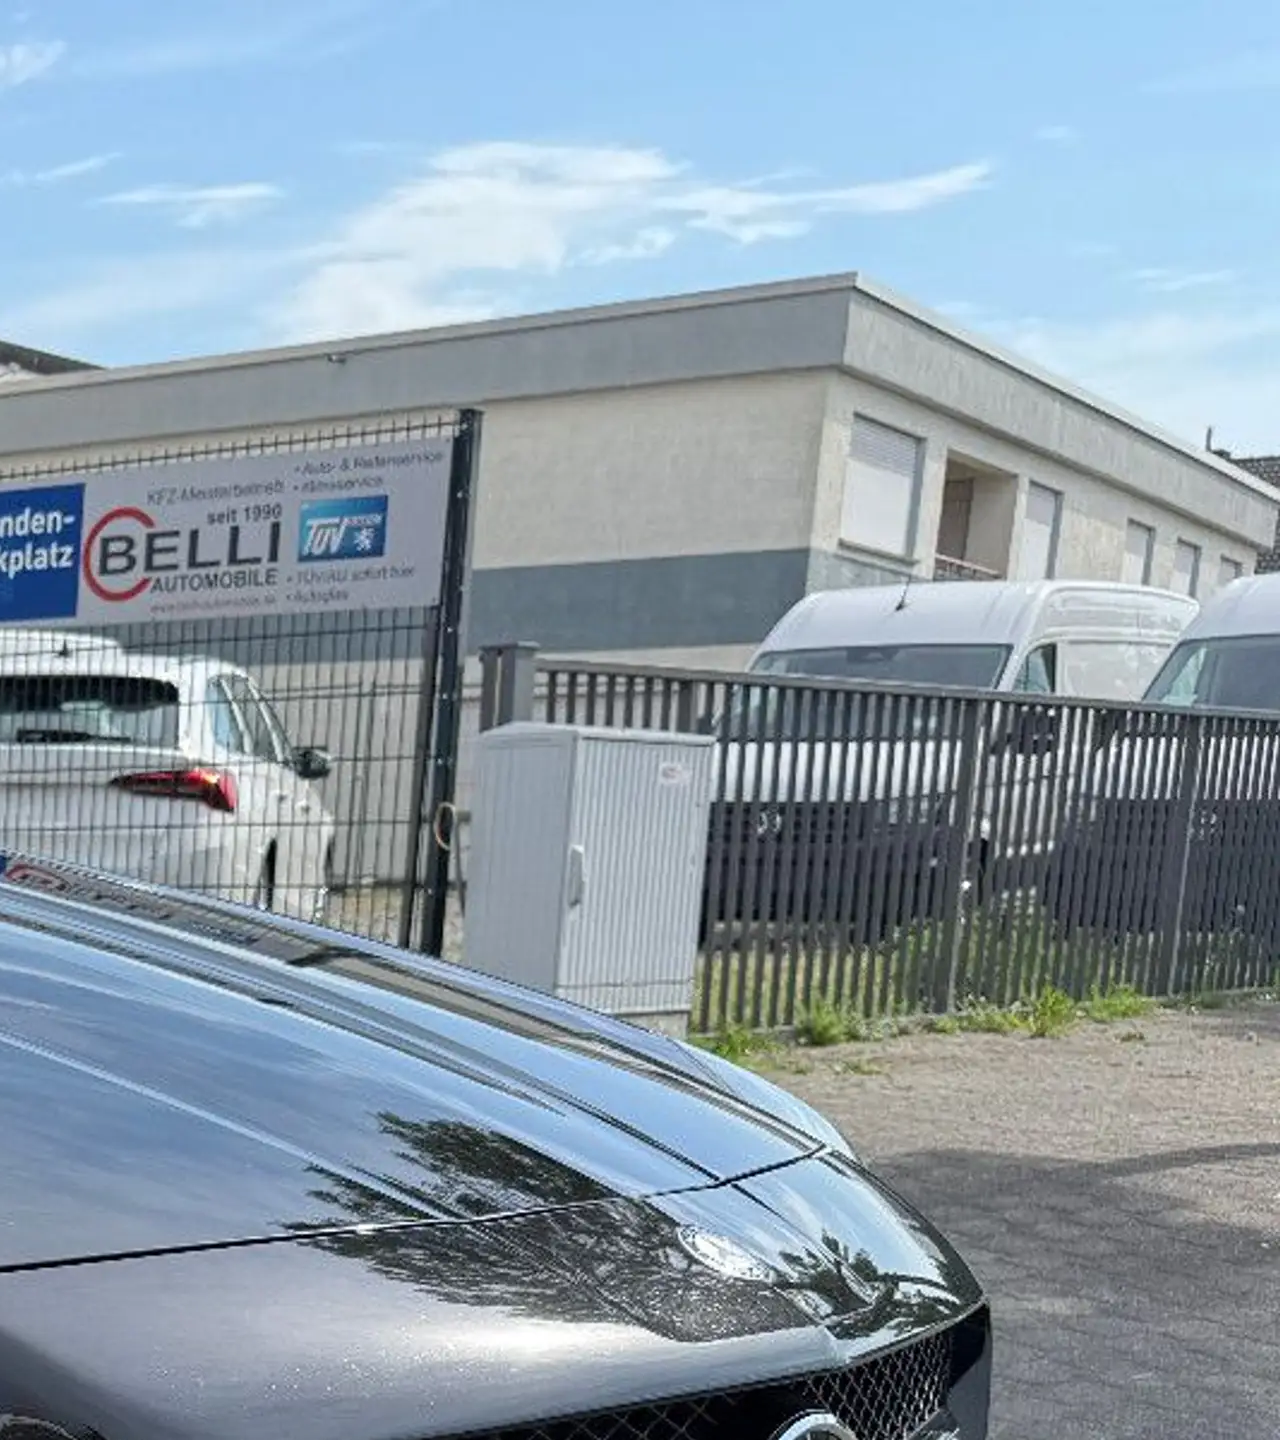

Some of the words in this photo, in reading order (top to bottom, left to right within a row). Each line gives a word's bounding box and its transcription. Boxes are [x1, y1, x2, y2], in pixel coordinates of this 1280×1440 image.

[207, 507, 238, 525] seit
[244, 503, 282, 522] 1990
[98, 521, 281, 577] BELLI
[151, 568, 279, 594] AUTOMOBILE
